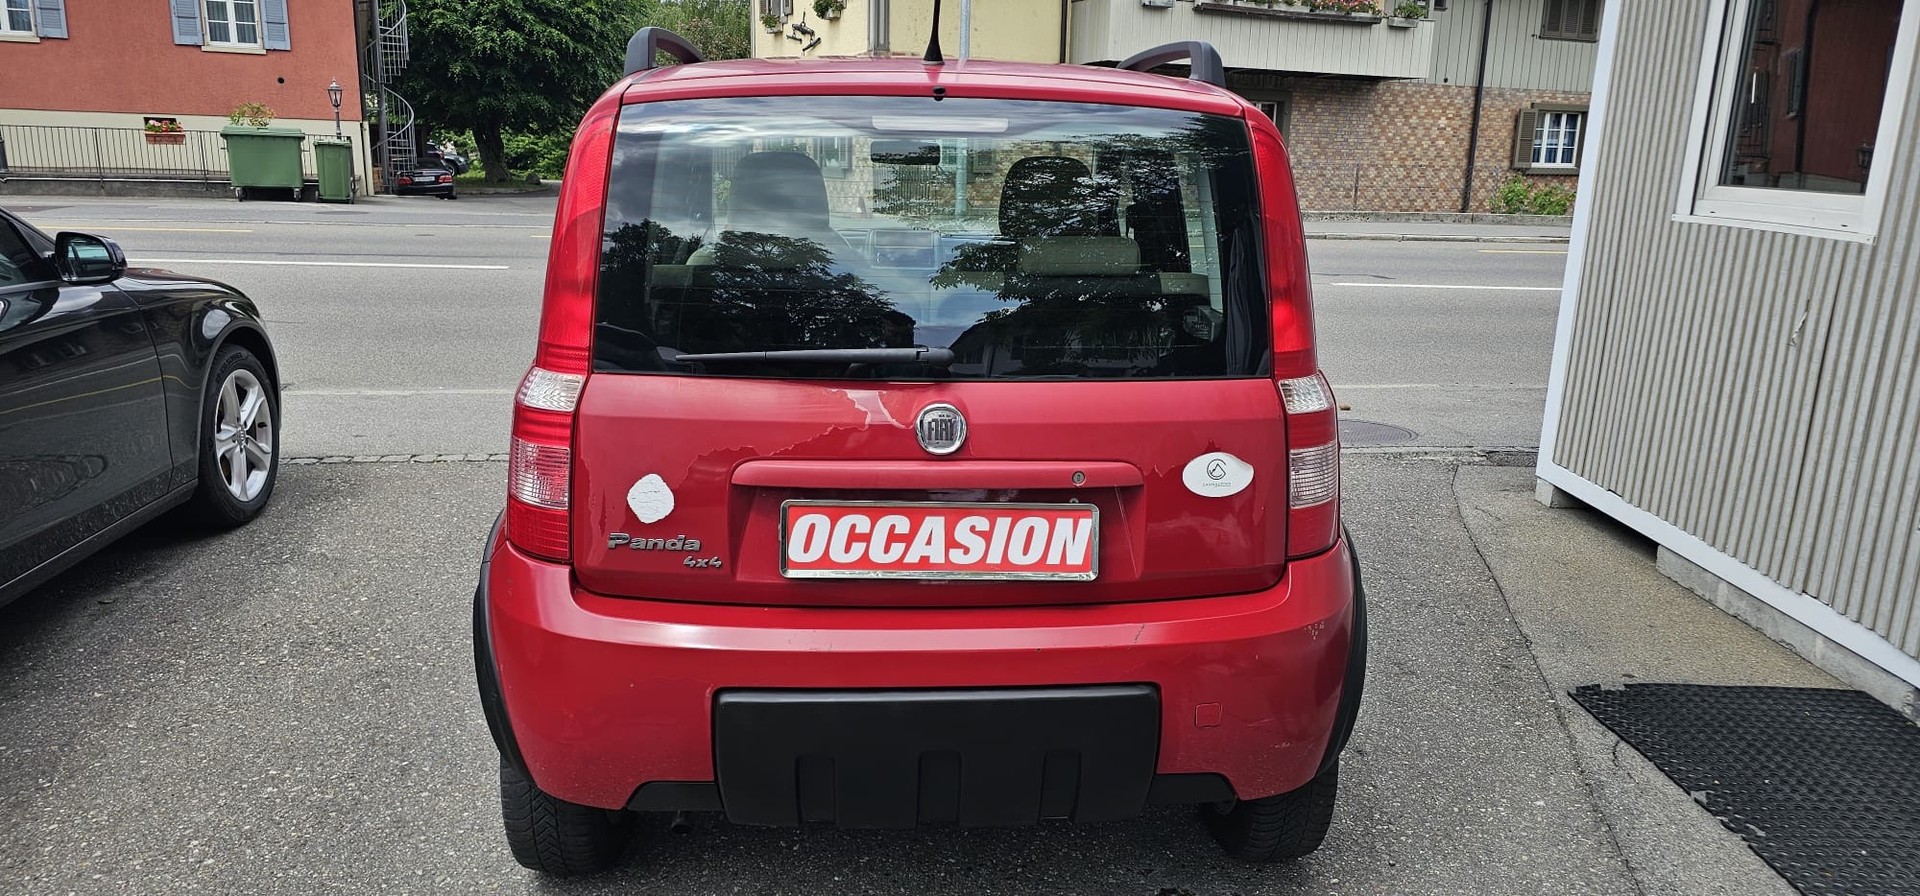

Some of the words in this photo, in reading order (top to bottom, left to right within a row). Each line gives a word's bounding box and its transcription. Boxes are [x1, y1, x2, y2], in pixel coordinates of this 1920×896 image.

[927, 418, 957, 441] FIAT
[607, 532, 702, 551] Panda
[788, 514, 1092, 566] OCCASION
[683, 555, 722, 568] 4x4
